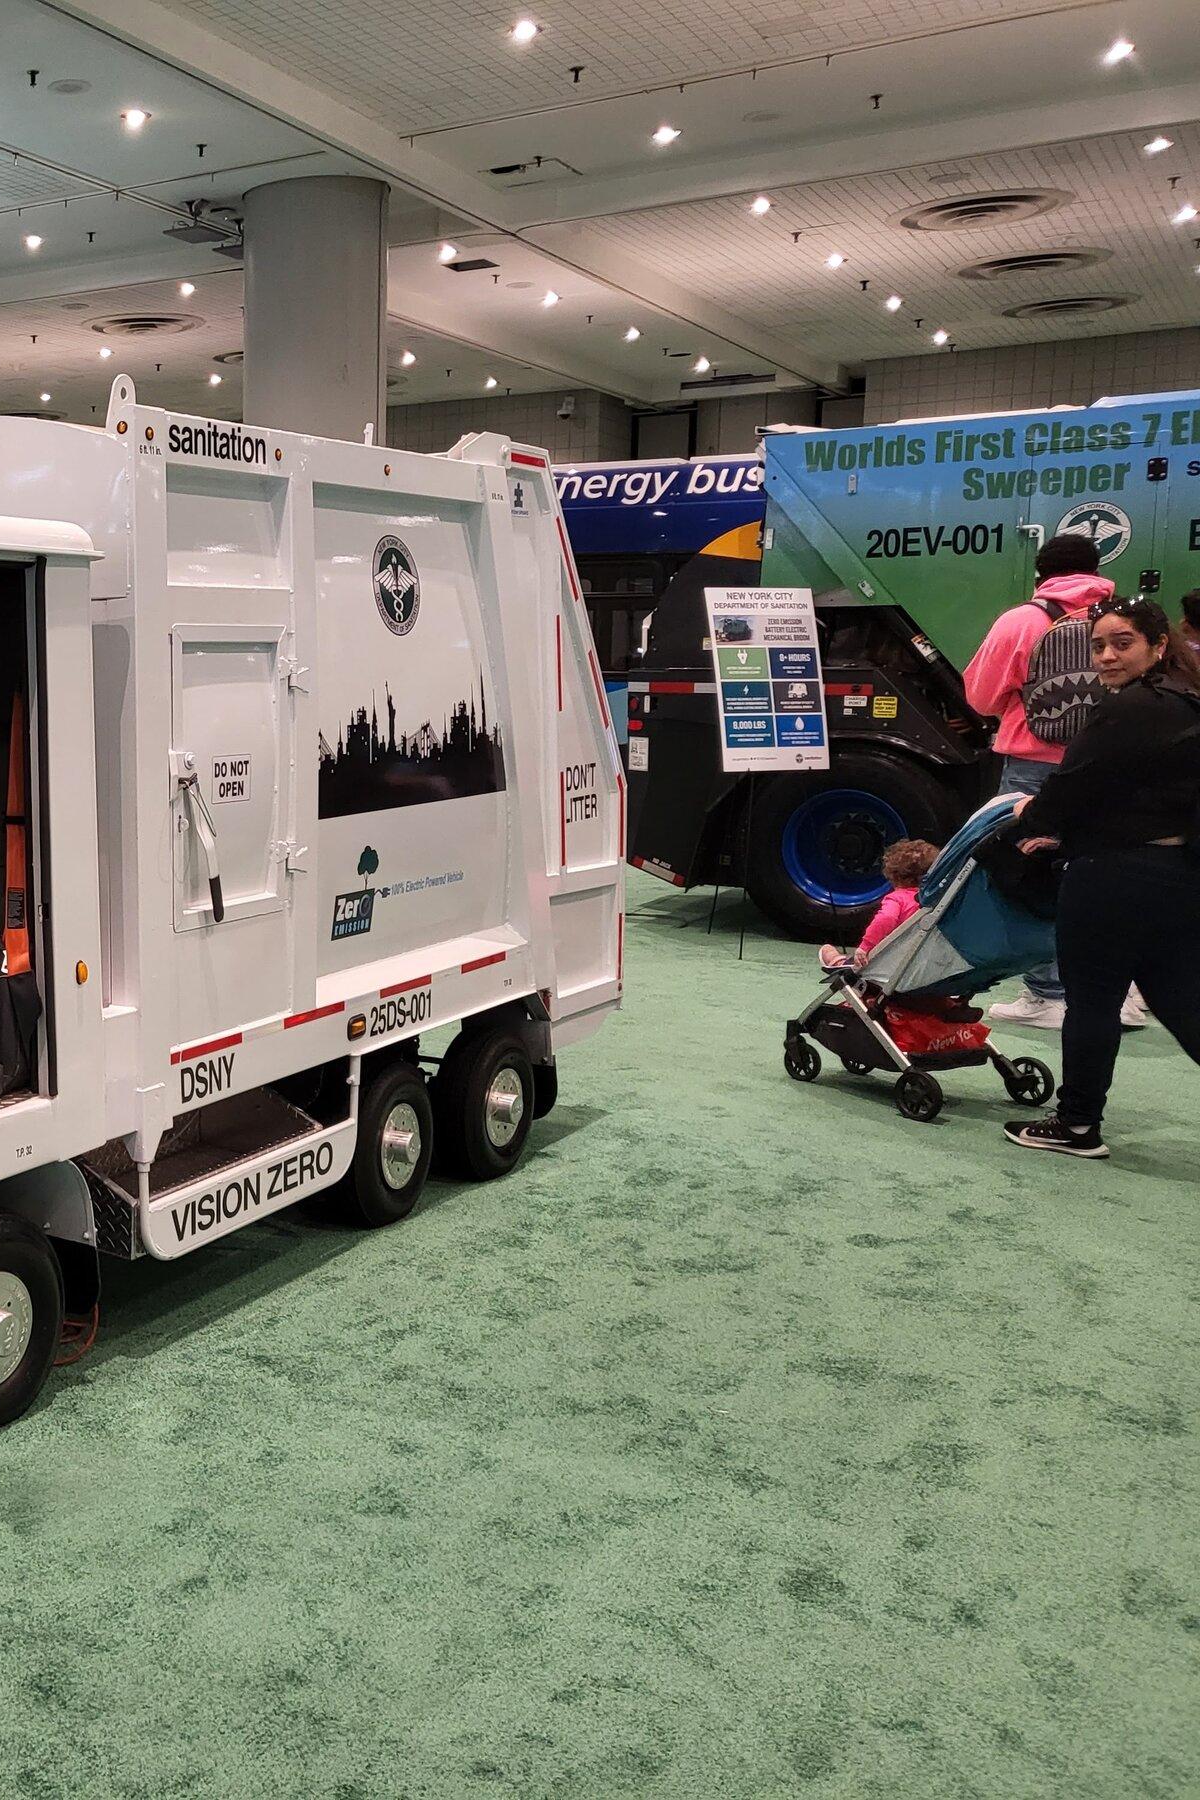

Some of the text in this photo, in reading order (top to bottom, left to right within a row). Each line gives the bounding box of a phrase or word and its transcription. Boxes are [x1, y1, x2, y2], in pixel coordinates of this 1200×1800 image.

[168, 422, 266, 464] sanitation
[805, 435, 926, 474] Worlds
[935, 427, 1016, 465] First
[1024, 420, 1132, 457] Class
[1142, 413, 1162, 448] 7
[555, 464, 766, 505] nergy bus
[962, 461, 1131, 502] Sweeper
[865, 523, 1005, 559] 20EV-001
[726, 592, 794, 601] NEW YORK CITY
[771, 602, 808, 610] SANITATION
[789, 653, 812, 662] HOURS
[214, 760, 250, 778] DO NOT
[566, 762, 597, 792] DON'T
[218, 780, 244, 798] OPEN
[370, 989, 432, 1037] 25DS-001
[180, 1053, 235, 1104] DSNY
[171, 1141, 334, 1242] VISION ZERO
